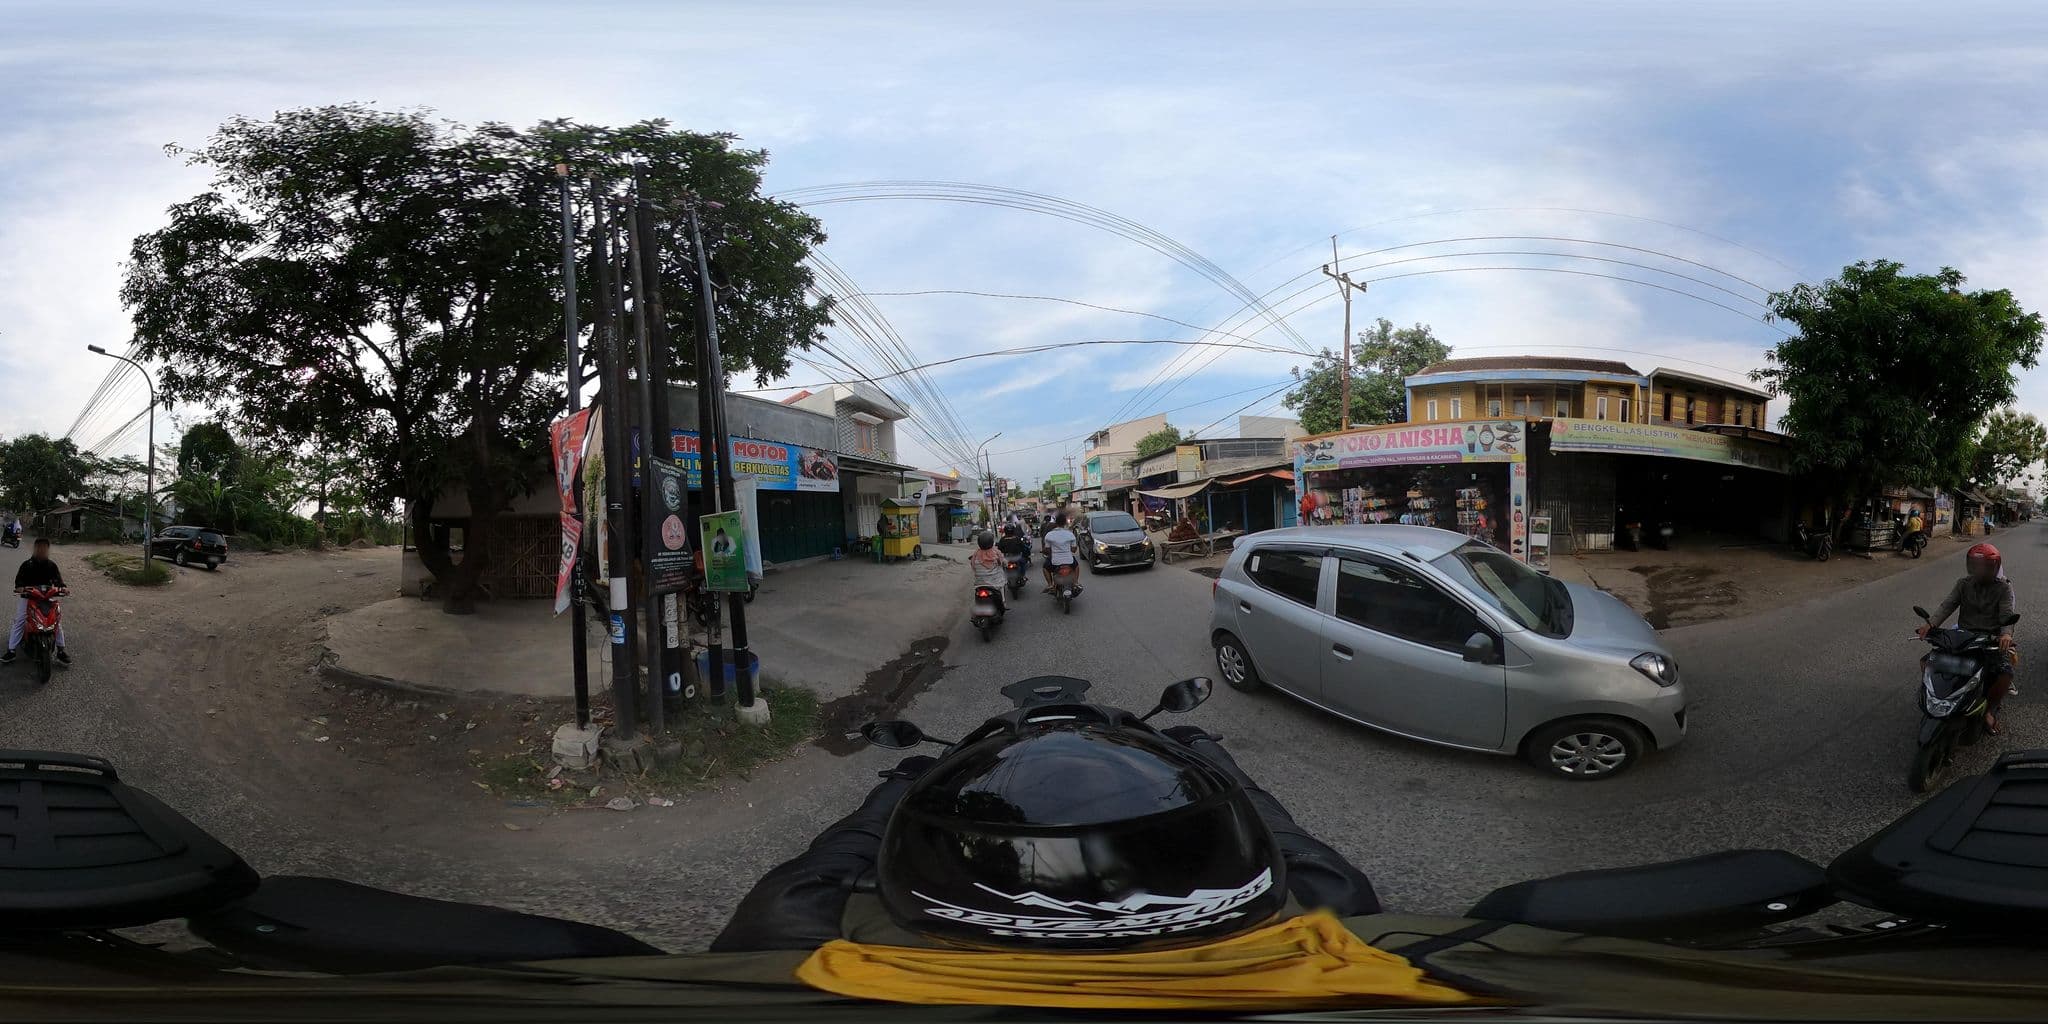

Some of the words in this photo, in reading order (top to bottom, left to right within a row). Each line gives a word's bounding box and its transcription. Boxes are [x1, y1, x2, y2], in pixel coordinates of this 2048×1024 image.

[1336, 435, 1381, 452] TOKO
[1385, 427, 1464, 448] ANISHA
[1573, 424, 1621, 434] BENGKEL
[1624, 427, 1641, 435] LAS
[1644, 429, 1679, 440] LISTRIK
[733, 441, 787, 461] MOTOR
[734, 462, 789, 476] BERKUALITAS
[923, 881, 1273, 930] ADVENTURE
[987, 911, 1246, 938] HONDA
